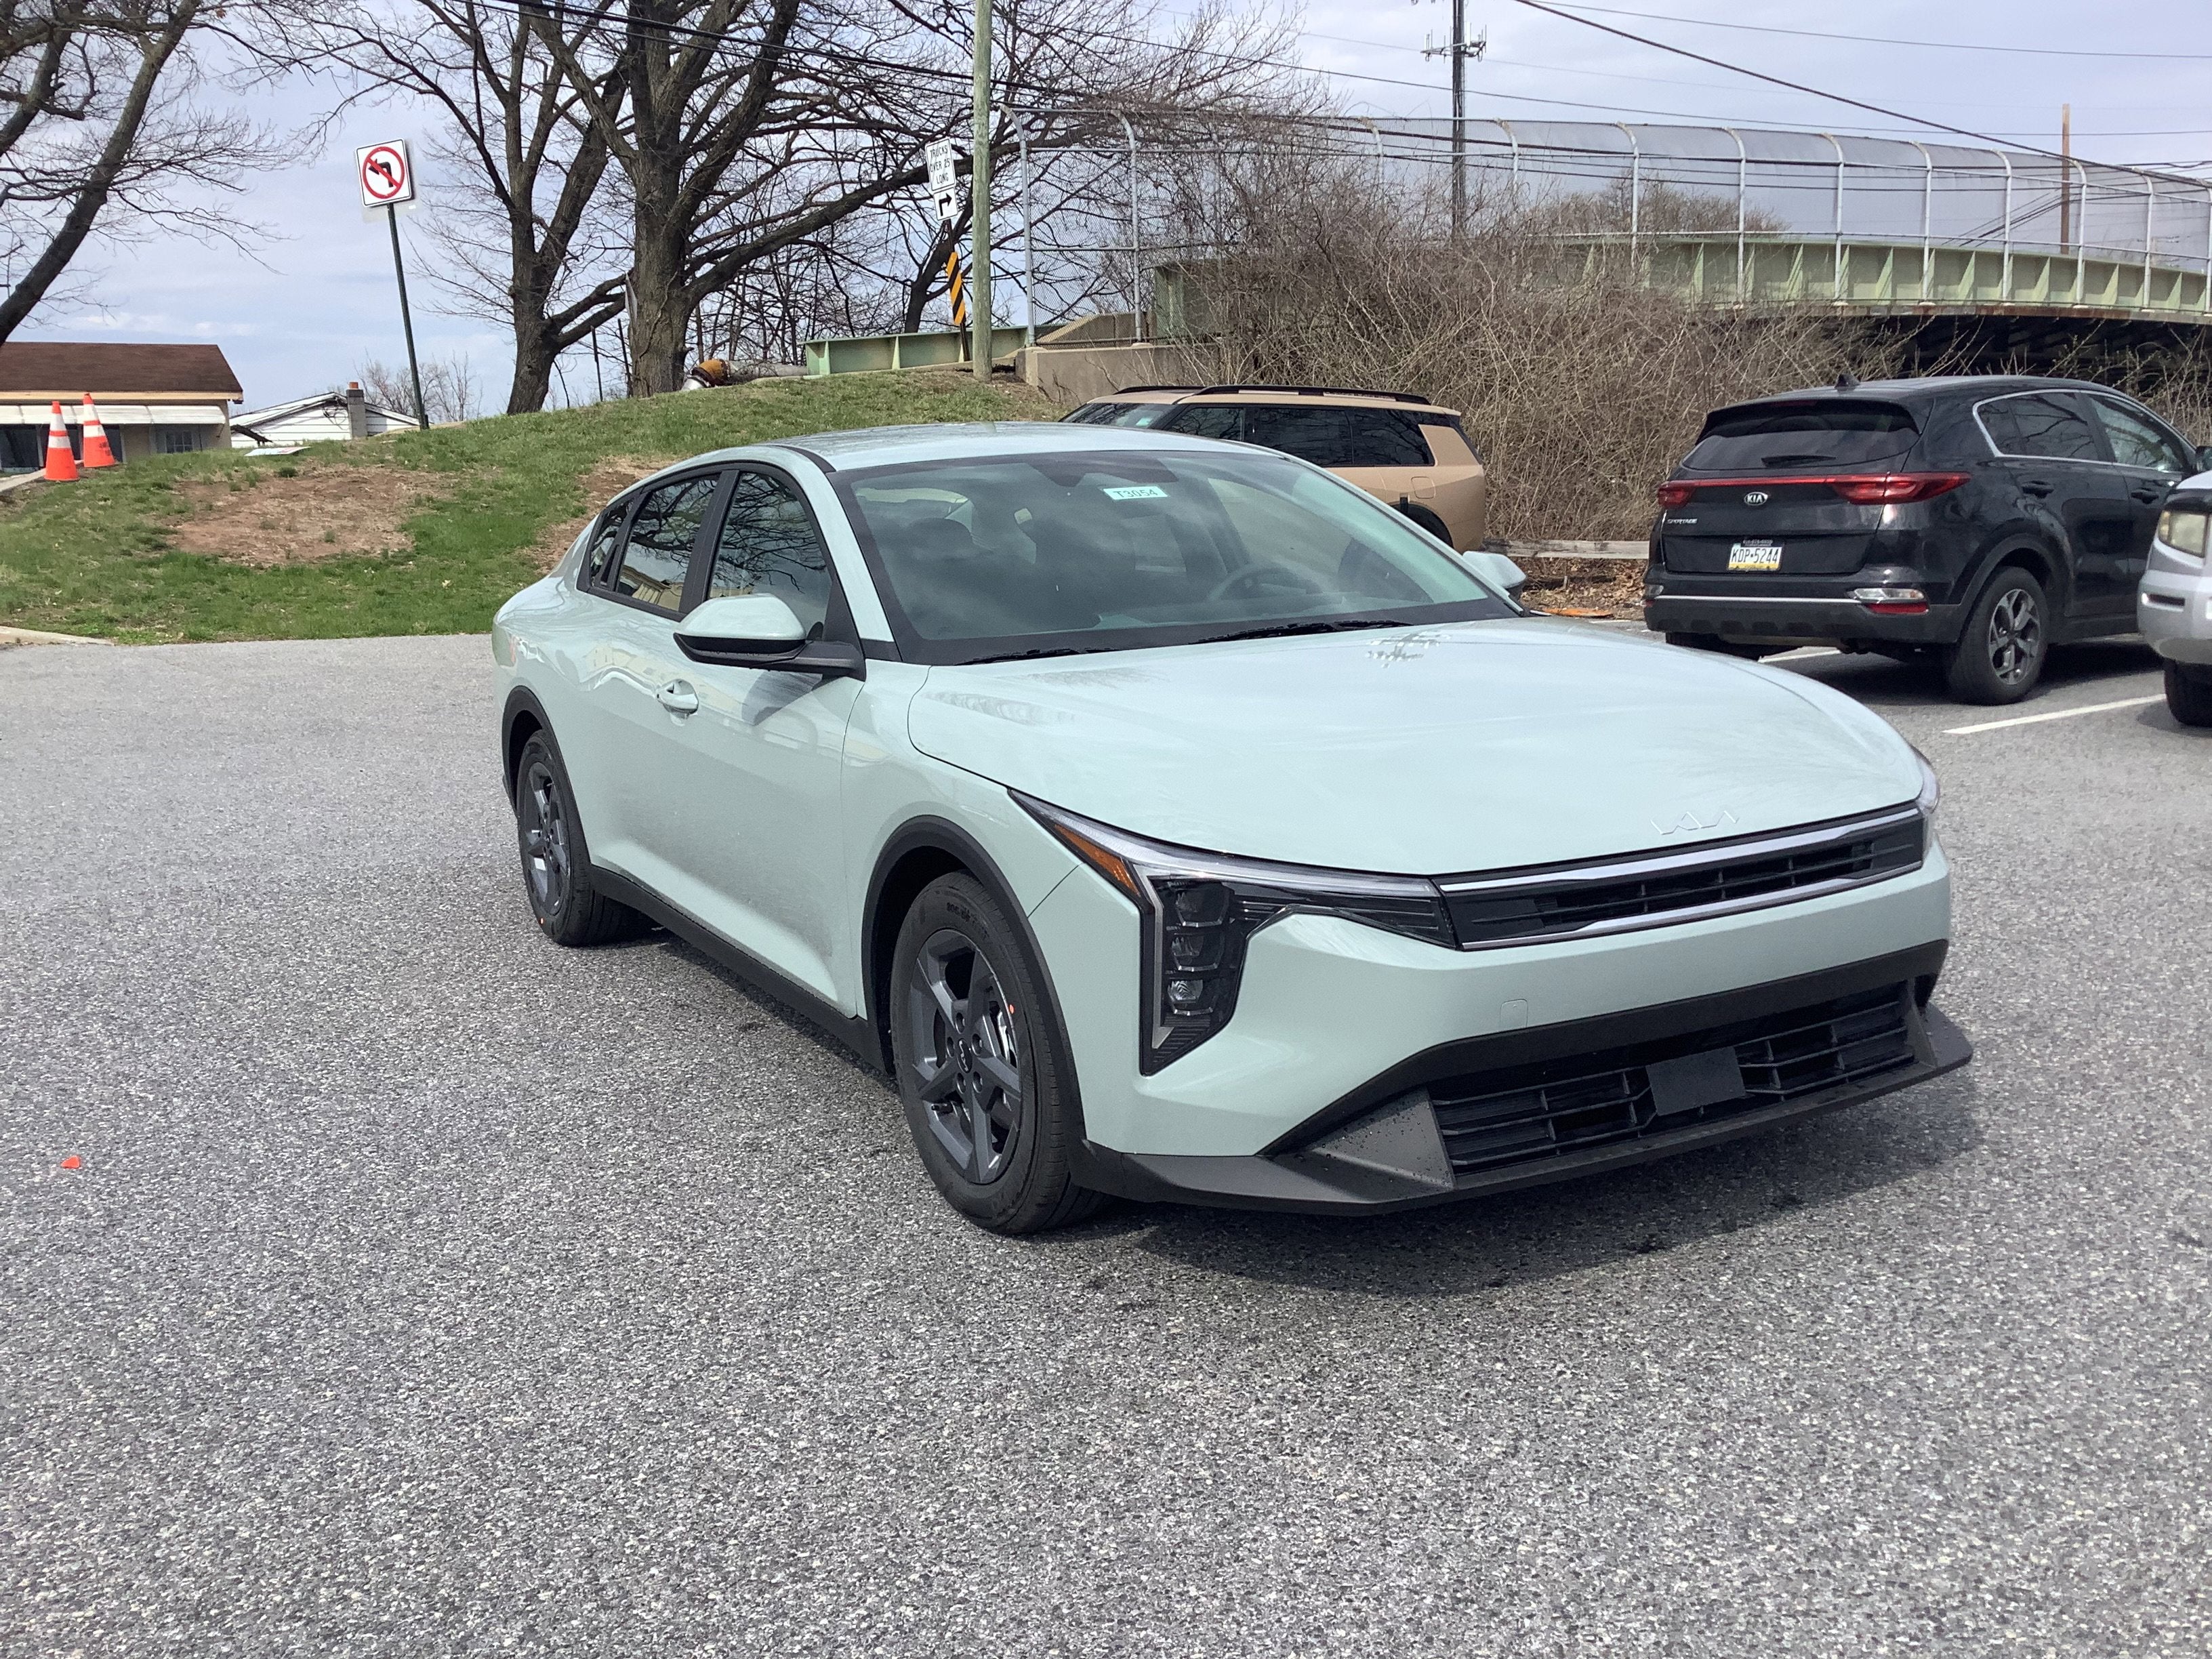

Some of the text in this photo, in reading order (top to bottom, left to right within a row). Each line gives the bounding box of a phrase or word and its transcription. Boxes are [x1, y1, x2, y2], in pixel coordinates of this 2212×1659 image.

[930, 145, 947, 159] TRUCKS
[930, 161, 942, 172] OVER
[937, 173, 949, 184] LONG
[1113, 489, 1158, 498] T3054
[1747, 495, 1763, 503] KIA
